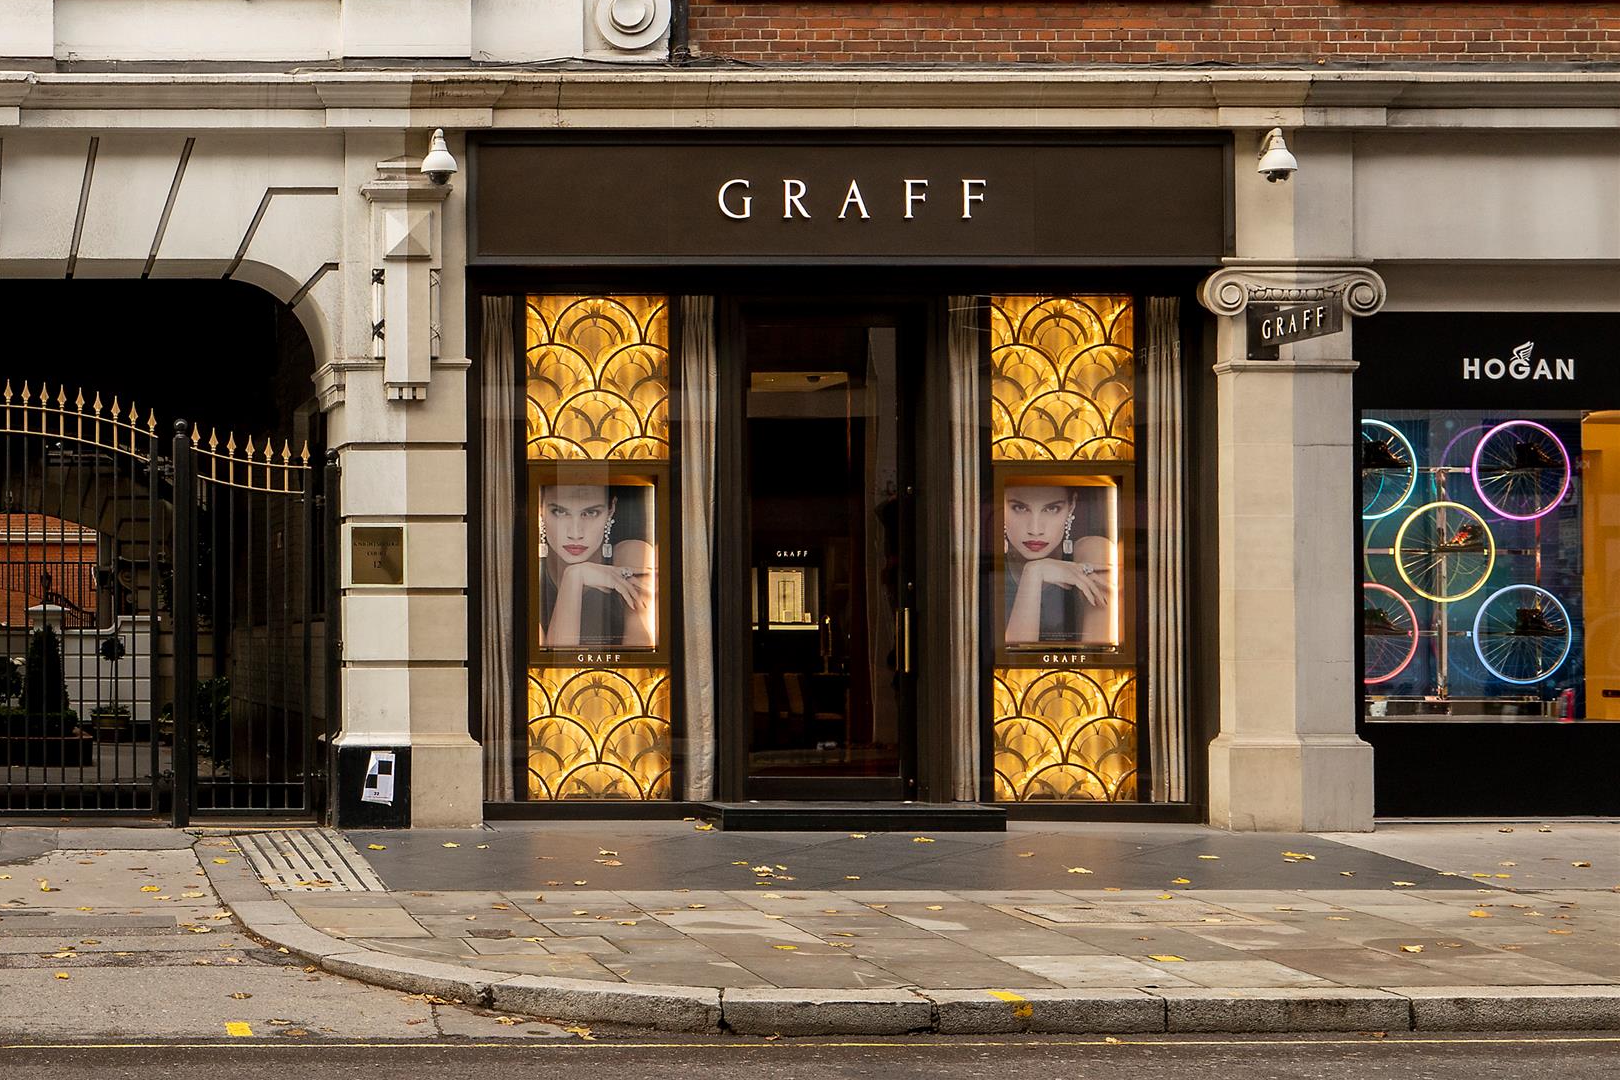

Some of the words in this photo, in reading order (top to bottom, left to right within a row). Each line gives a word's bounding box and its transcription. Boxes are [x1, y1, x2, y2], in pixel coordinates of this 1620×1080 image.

[717, 178, 986, 219] GRAFF
[1261, 306, 1329, 340] GRAFF
[1463, 358, 1575, 380] HOGAN
[776, 550, 808, 558] GRAFF
[577, 654, 621, 662] GRAFF
[1042, 654, 1087, 663] GRAFF
